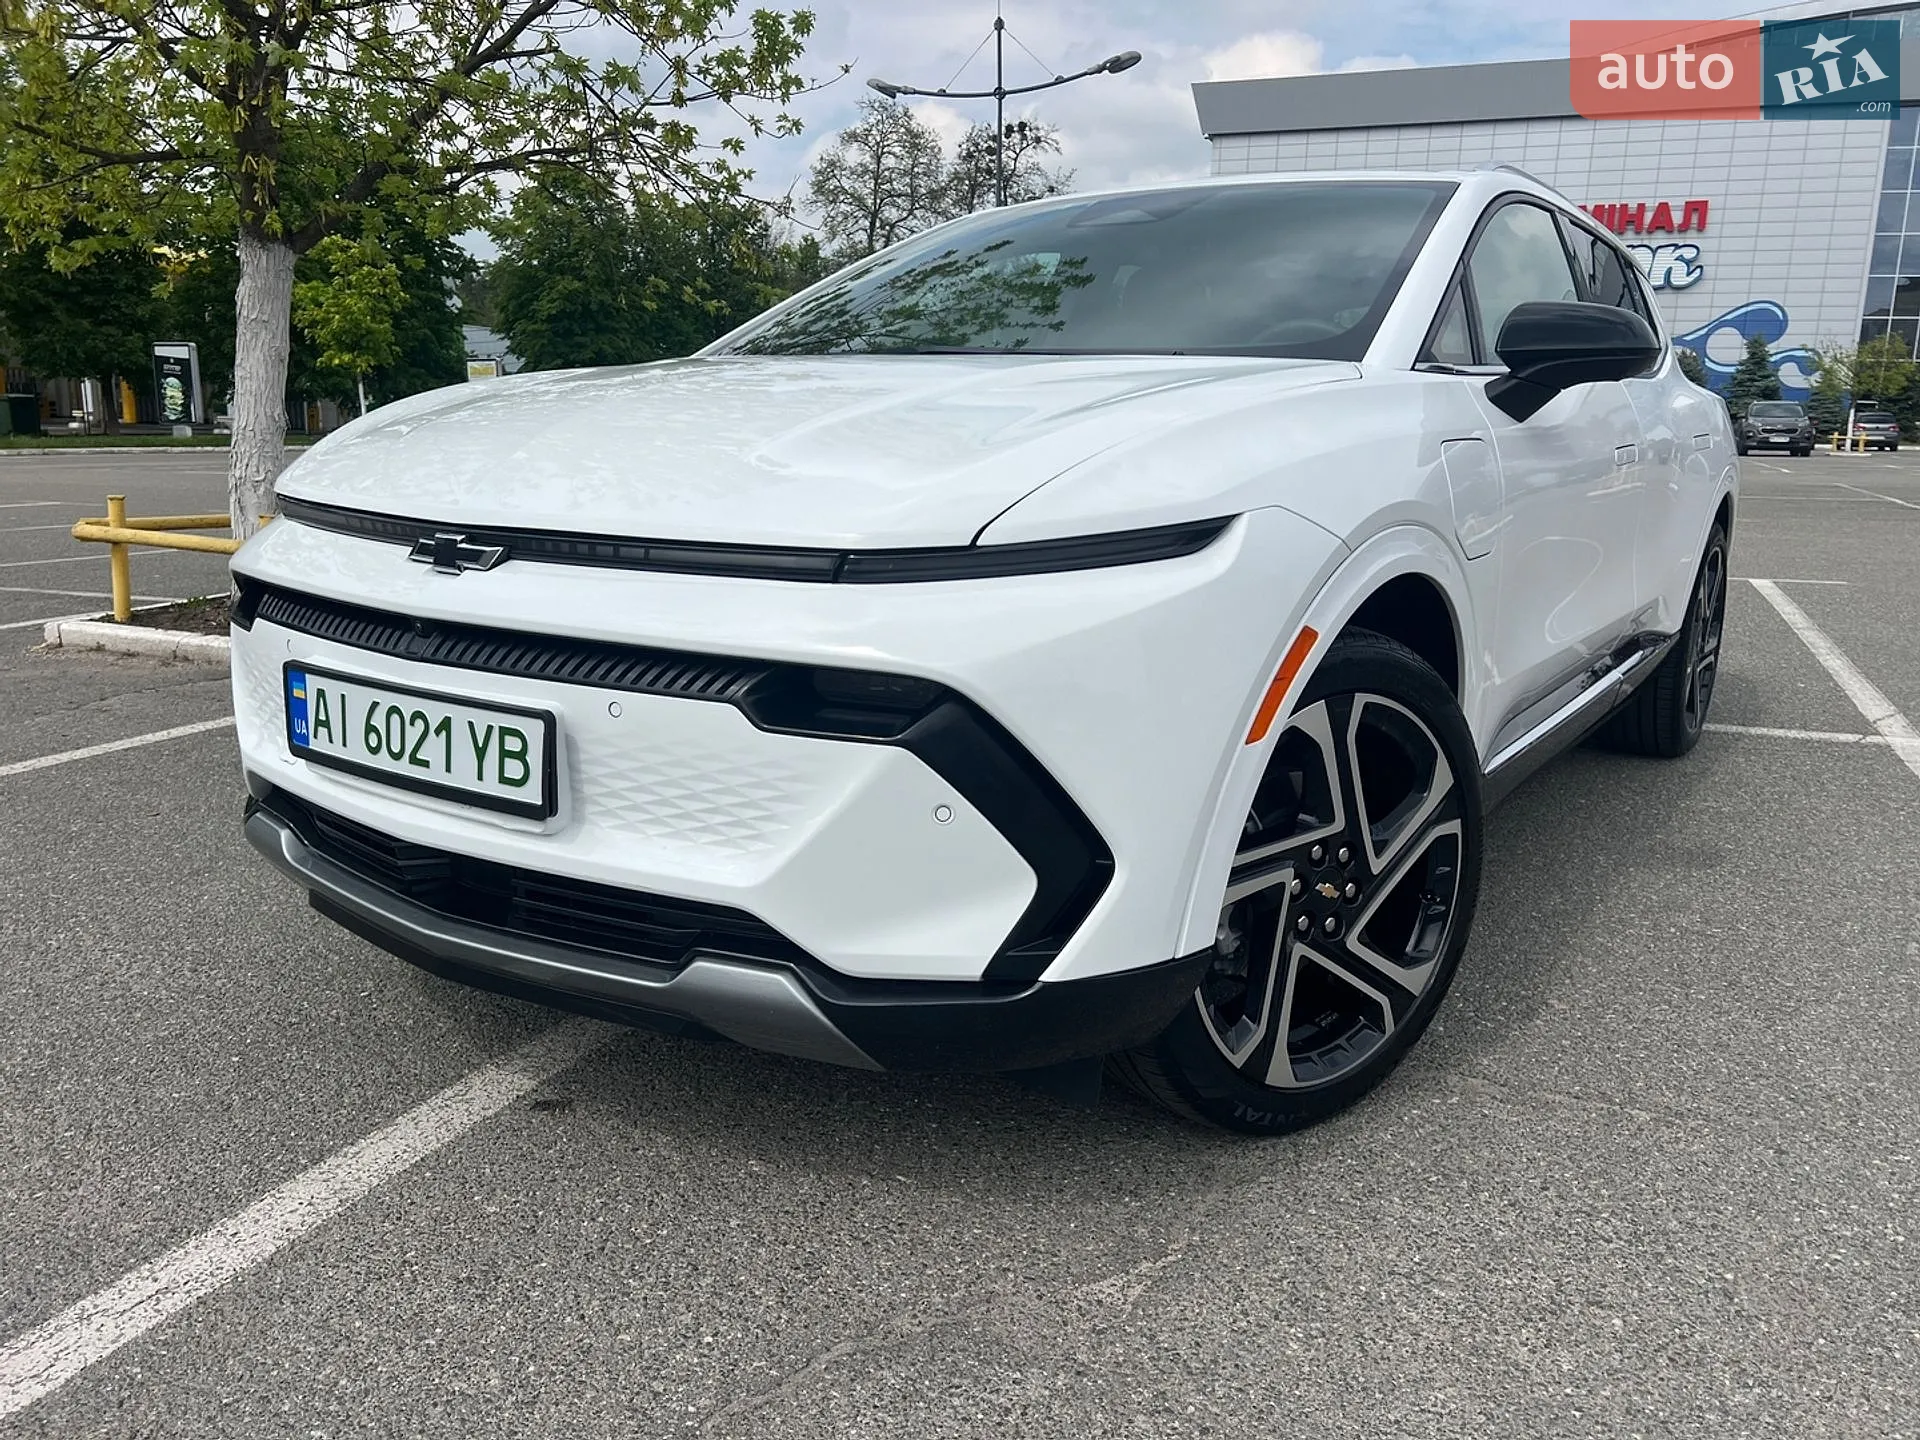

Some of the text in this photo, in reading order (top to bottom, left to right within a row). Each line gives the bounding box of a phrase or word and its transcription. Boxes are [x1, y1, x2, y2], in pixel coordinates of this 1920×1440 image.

[294, 716, 308, 737] UA
[313, 688, 531, 788] AI 6021 YB
